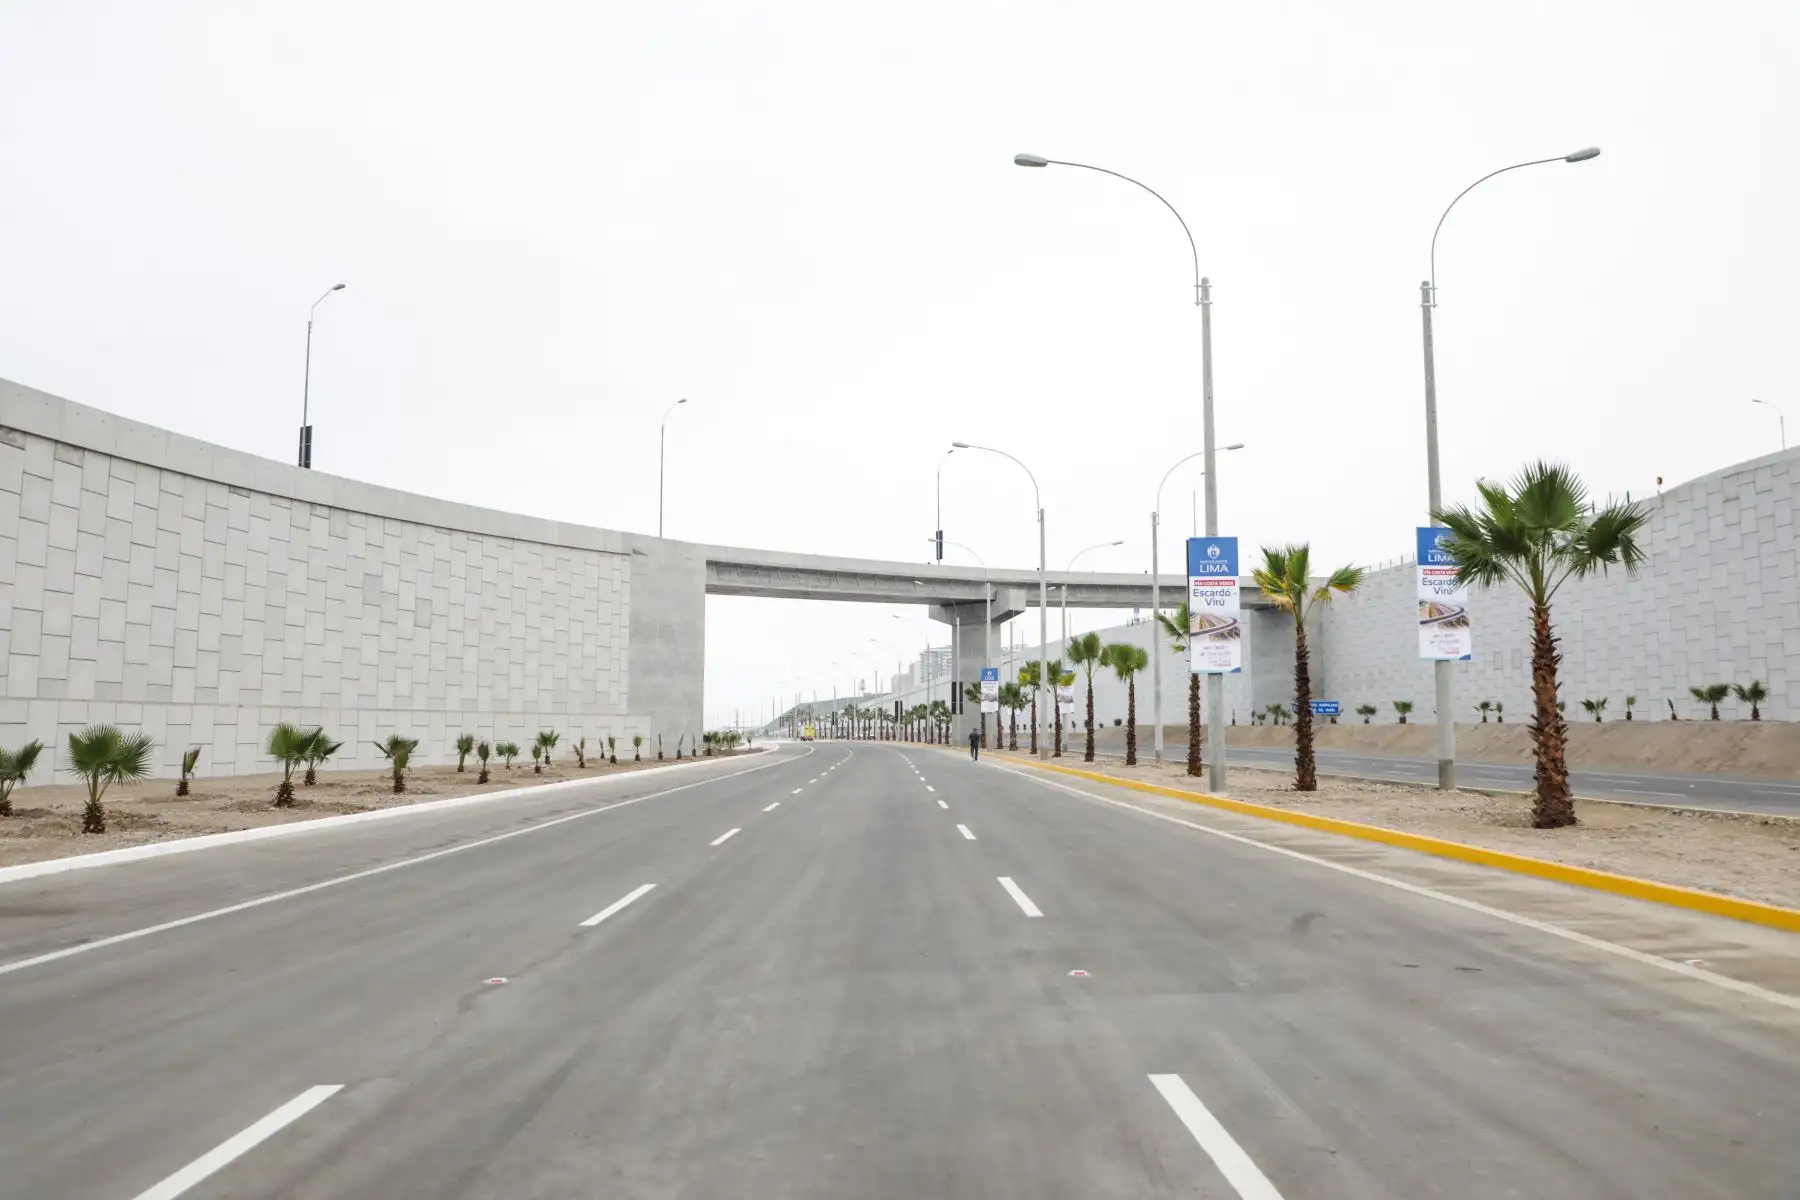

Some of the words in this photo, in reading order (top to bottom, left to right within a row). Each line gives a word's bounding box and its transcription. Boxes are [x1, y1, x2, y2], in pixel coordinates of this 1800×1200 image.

[1427, 554, 1456, 562] LIMA
[1199, 564, 1229, 573] LIMA
[1193, 588, 1231, 597] Escardó
